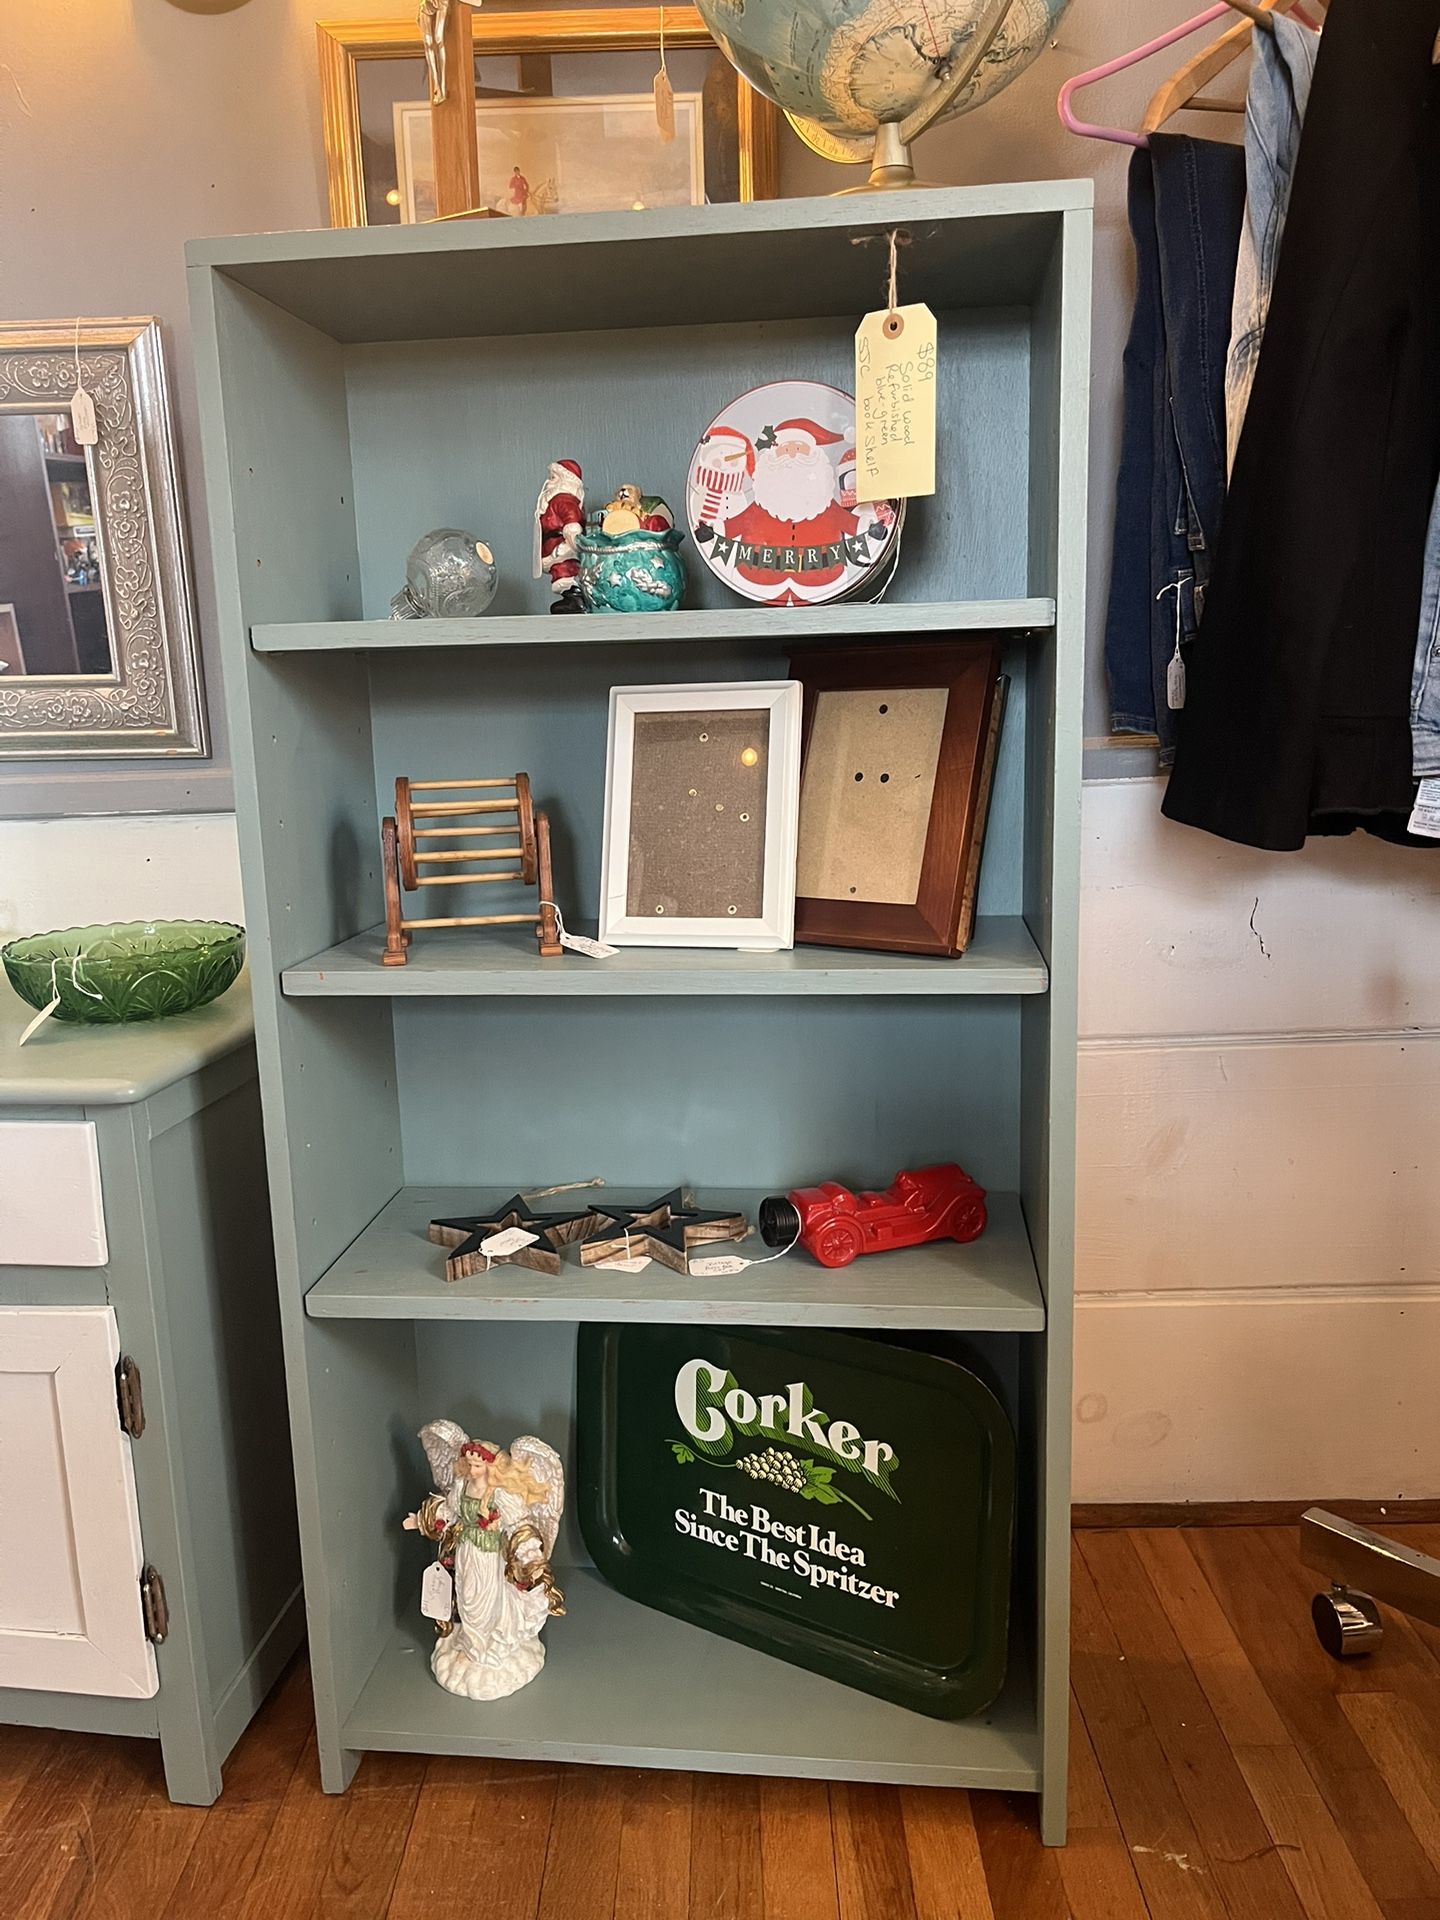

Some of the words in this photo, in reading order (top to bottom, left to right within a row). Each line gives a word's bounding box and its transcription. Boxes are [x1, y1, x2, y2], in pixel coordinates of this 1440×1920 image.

[899, 361, 915, 402] Solid
[916, 342, 935, 382] $89
[863, 395, 875, 431] book
[738, 545, 842, 565] MERRY
[674, 1358, 897, 1480] Corker
[699, 1487, 749, 1527] The
[750, 1504, 806, 1547] Best
[808, 1523, 867, 1567] Idea
[674, 1508, 739, 1552] Since
[739, 1530, 790, 1570] The
[793, 1550, 900, 1609] Spritzer
